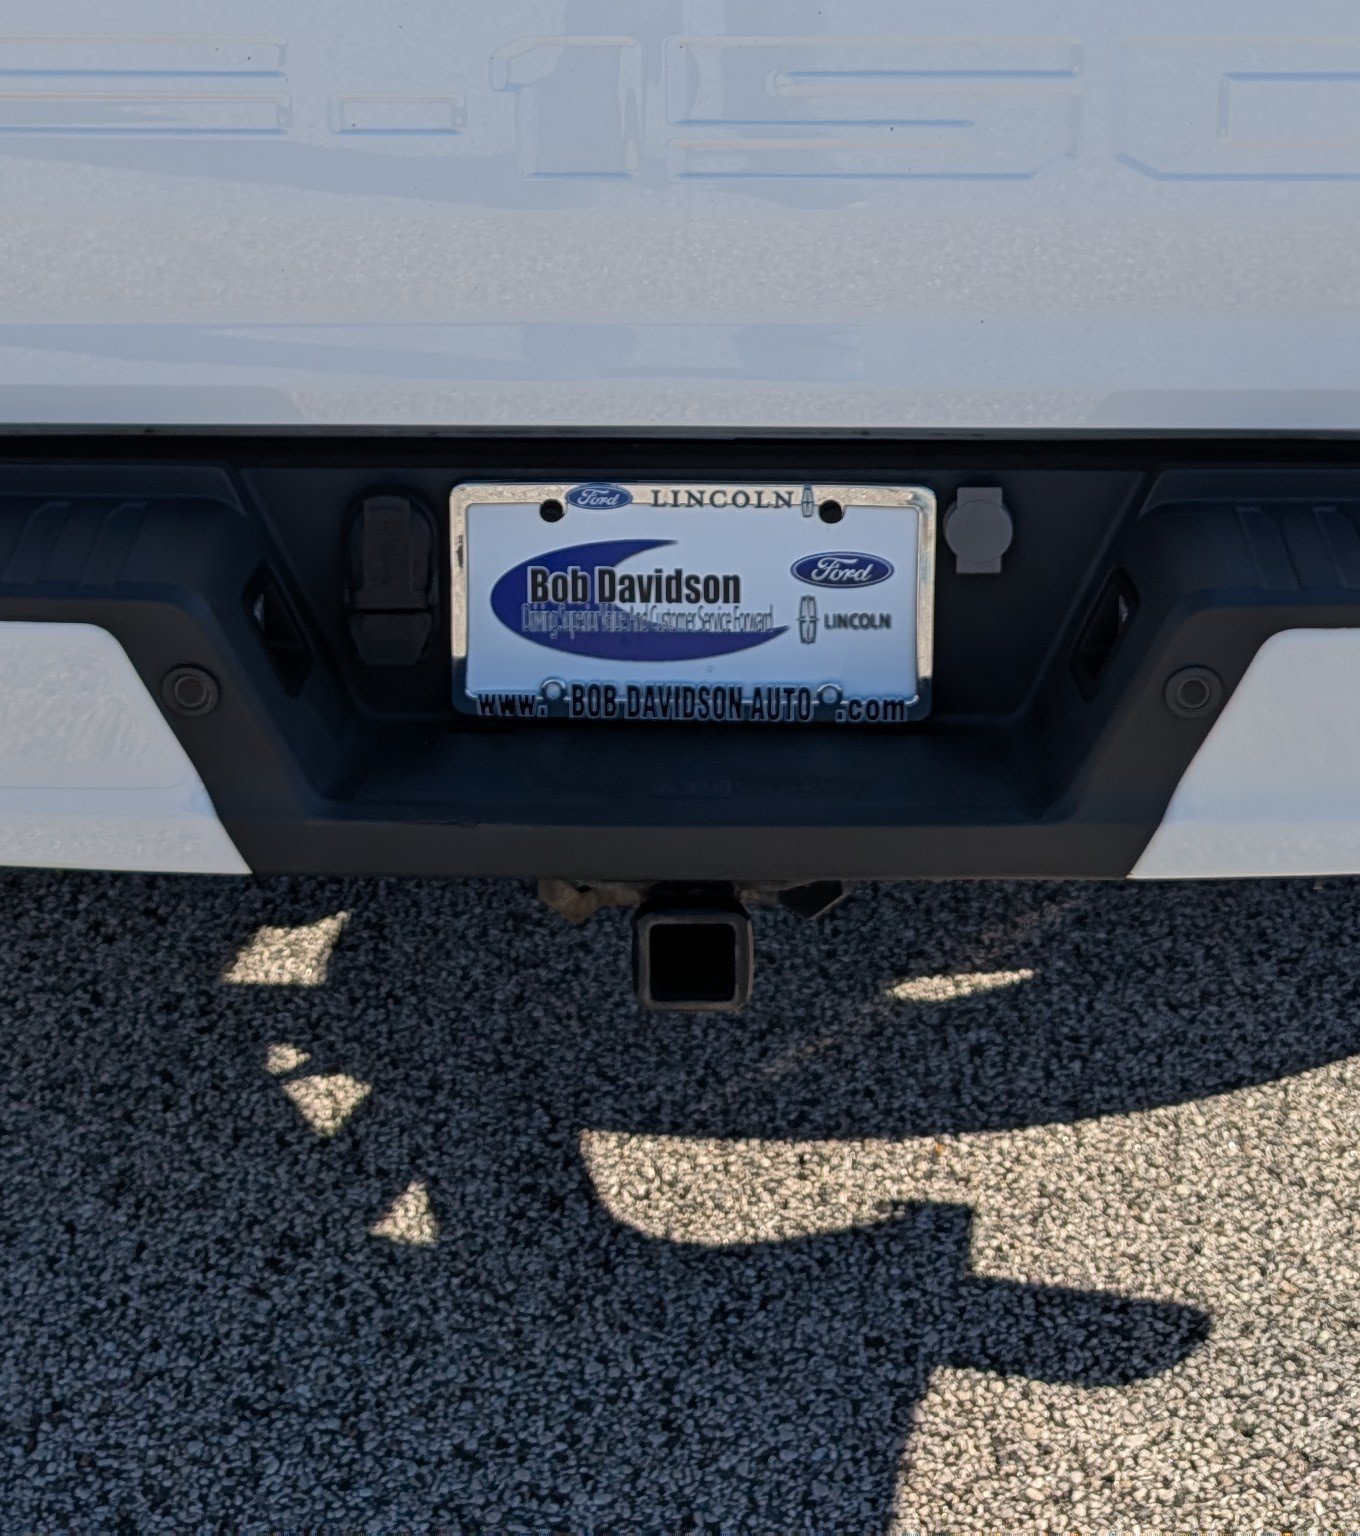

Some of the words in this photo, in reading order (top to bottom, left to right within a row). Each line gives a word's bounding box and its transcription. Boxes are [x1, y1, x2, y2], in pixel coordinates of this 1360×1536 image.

[650, 489, 794, 509] LINCOLN
[528, 565, 590, 604] Bob
[594, 565, 742, 604] Davidson
[697, 604, 732, 632] Service
[823, 612, 892, 630] LINCOLN
[569, 681, 617, 720] BOB
[624, 681, 742, 722] DAVIDSON
[750, 684, 814, 722] AUTO
